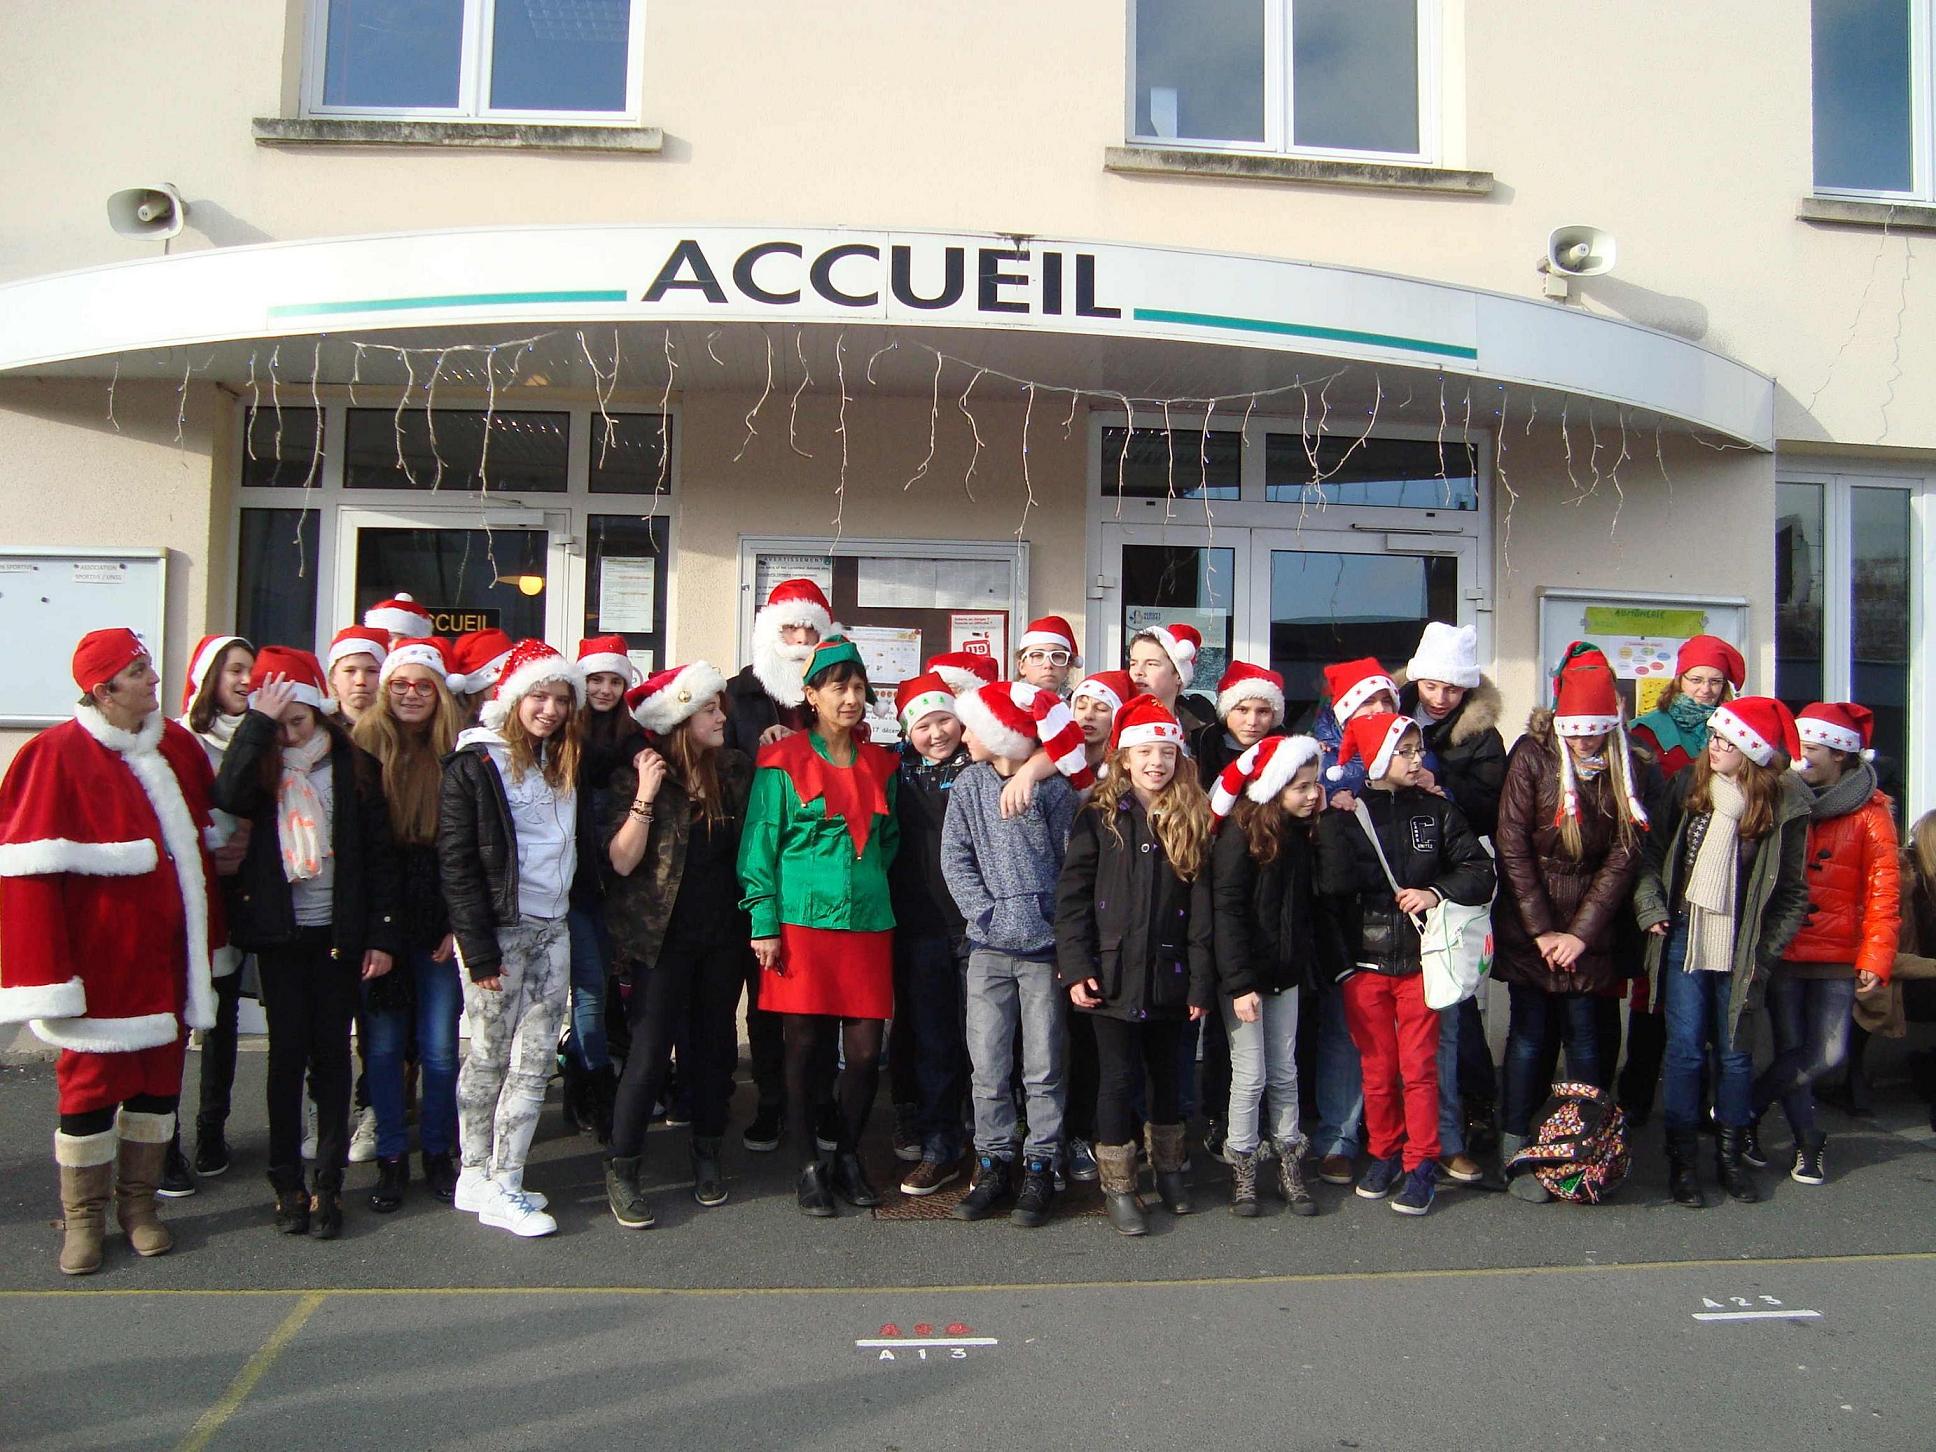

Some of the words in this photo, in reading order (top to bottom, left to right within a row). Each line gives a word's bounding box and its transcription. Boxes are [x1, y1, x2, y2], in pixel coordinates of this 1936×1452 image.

[641, 239, 1122, 318] ACCUEIL
[428, 613, 487, 632] CUEIL
[968, 645, 986, 653] 119
[881, 725, 900, 734] décem
